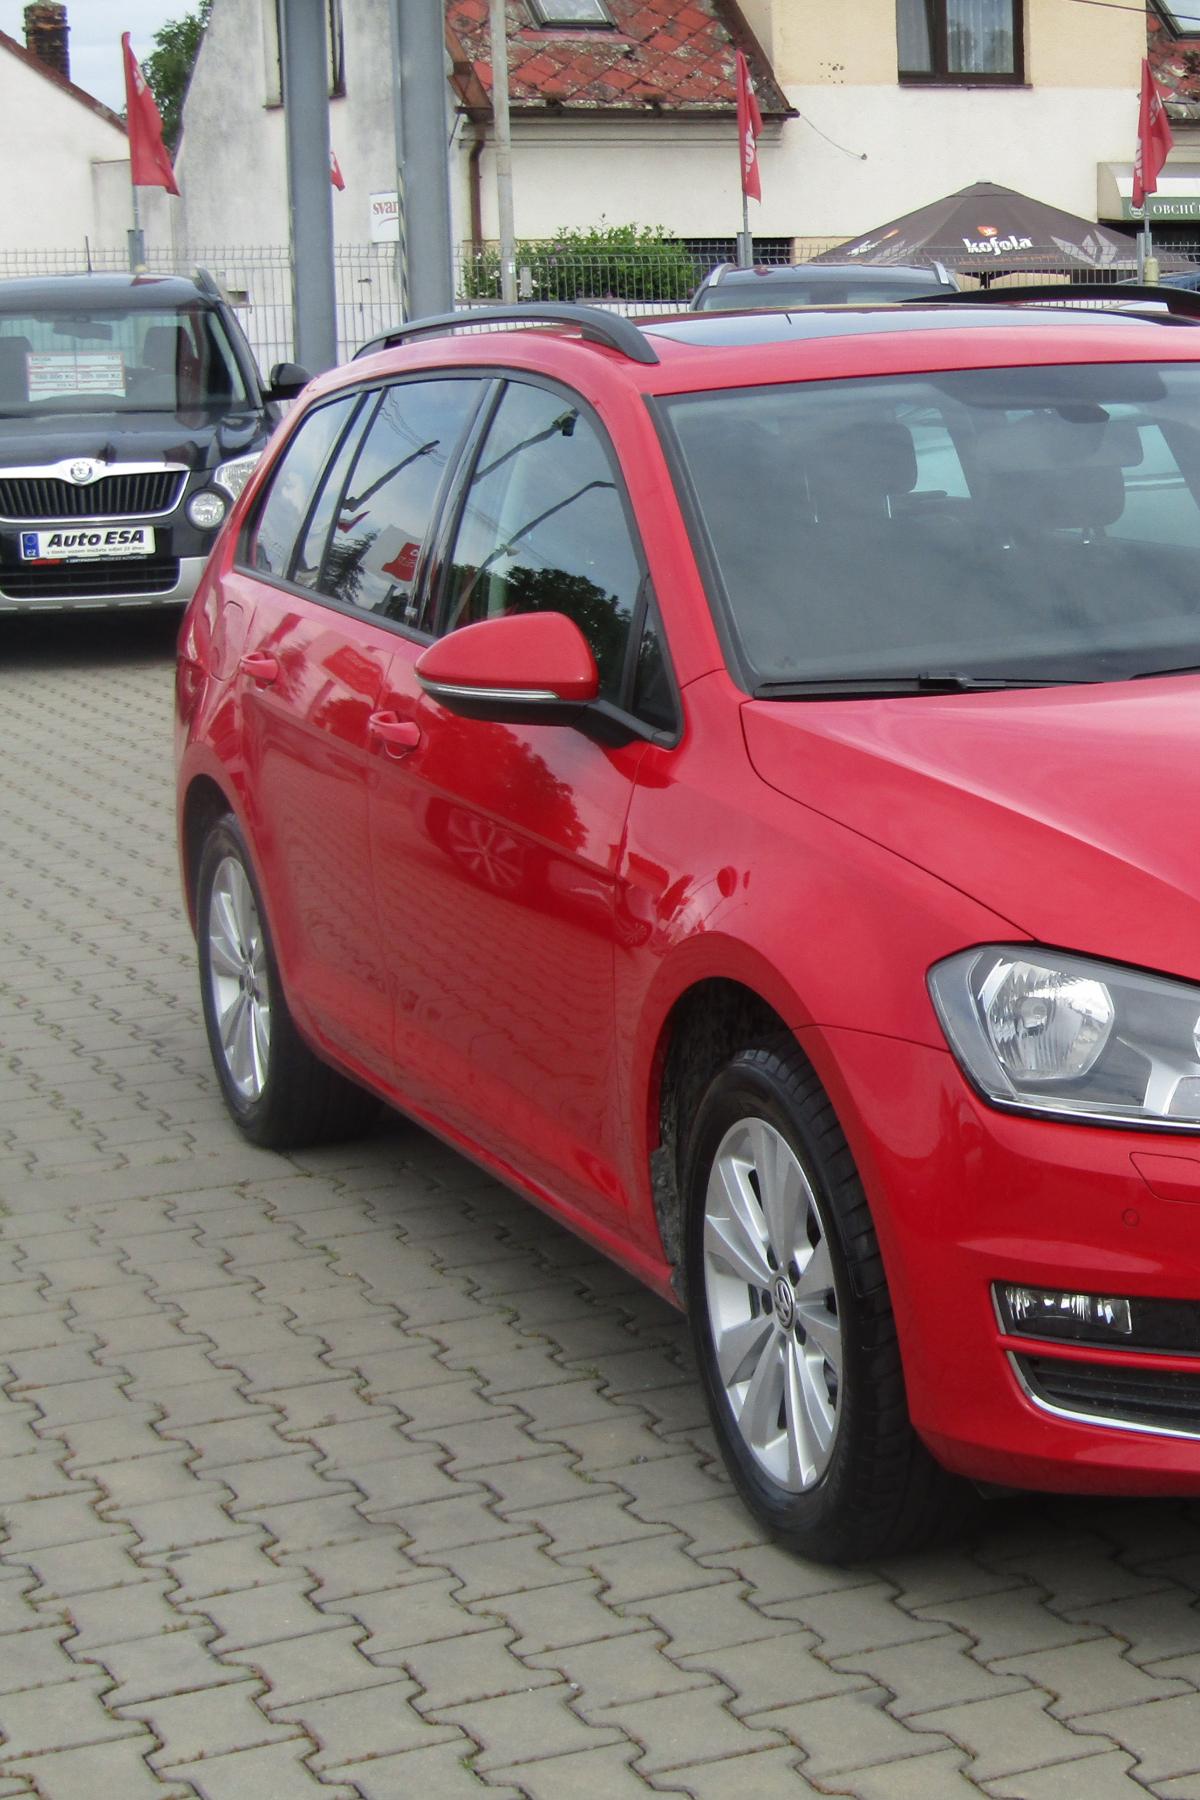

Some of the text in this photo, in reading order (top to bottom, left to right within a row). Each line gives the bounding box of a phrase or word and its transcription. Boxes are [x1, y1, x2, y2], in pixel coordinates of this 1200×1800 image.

[962, 235, 1032, 256] kofola
[48, 529, 145, 548] Auto ESA
